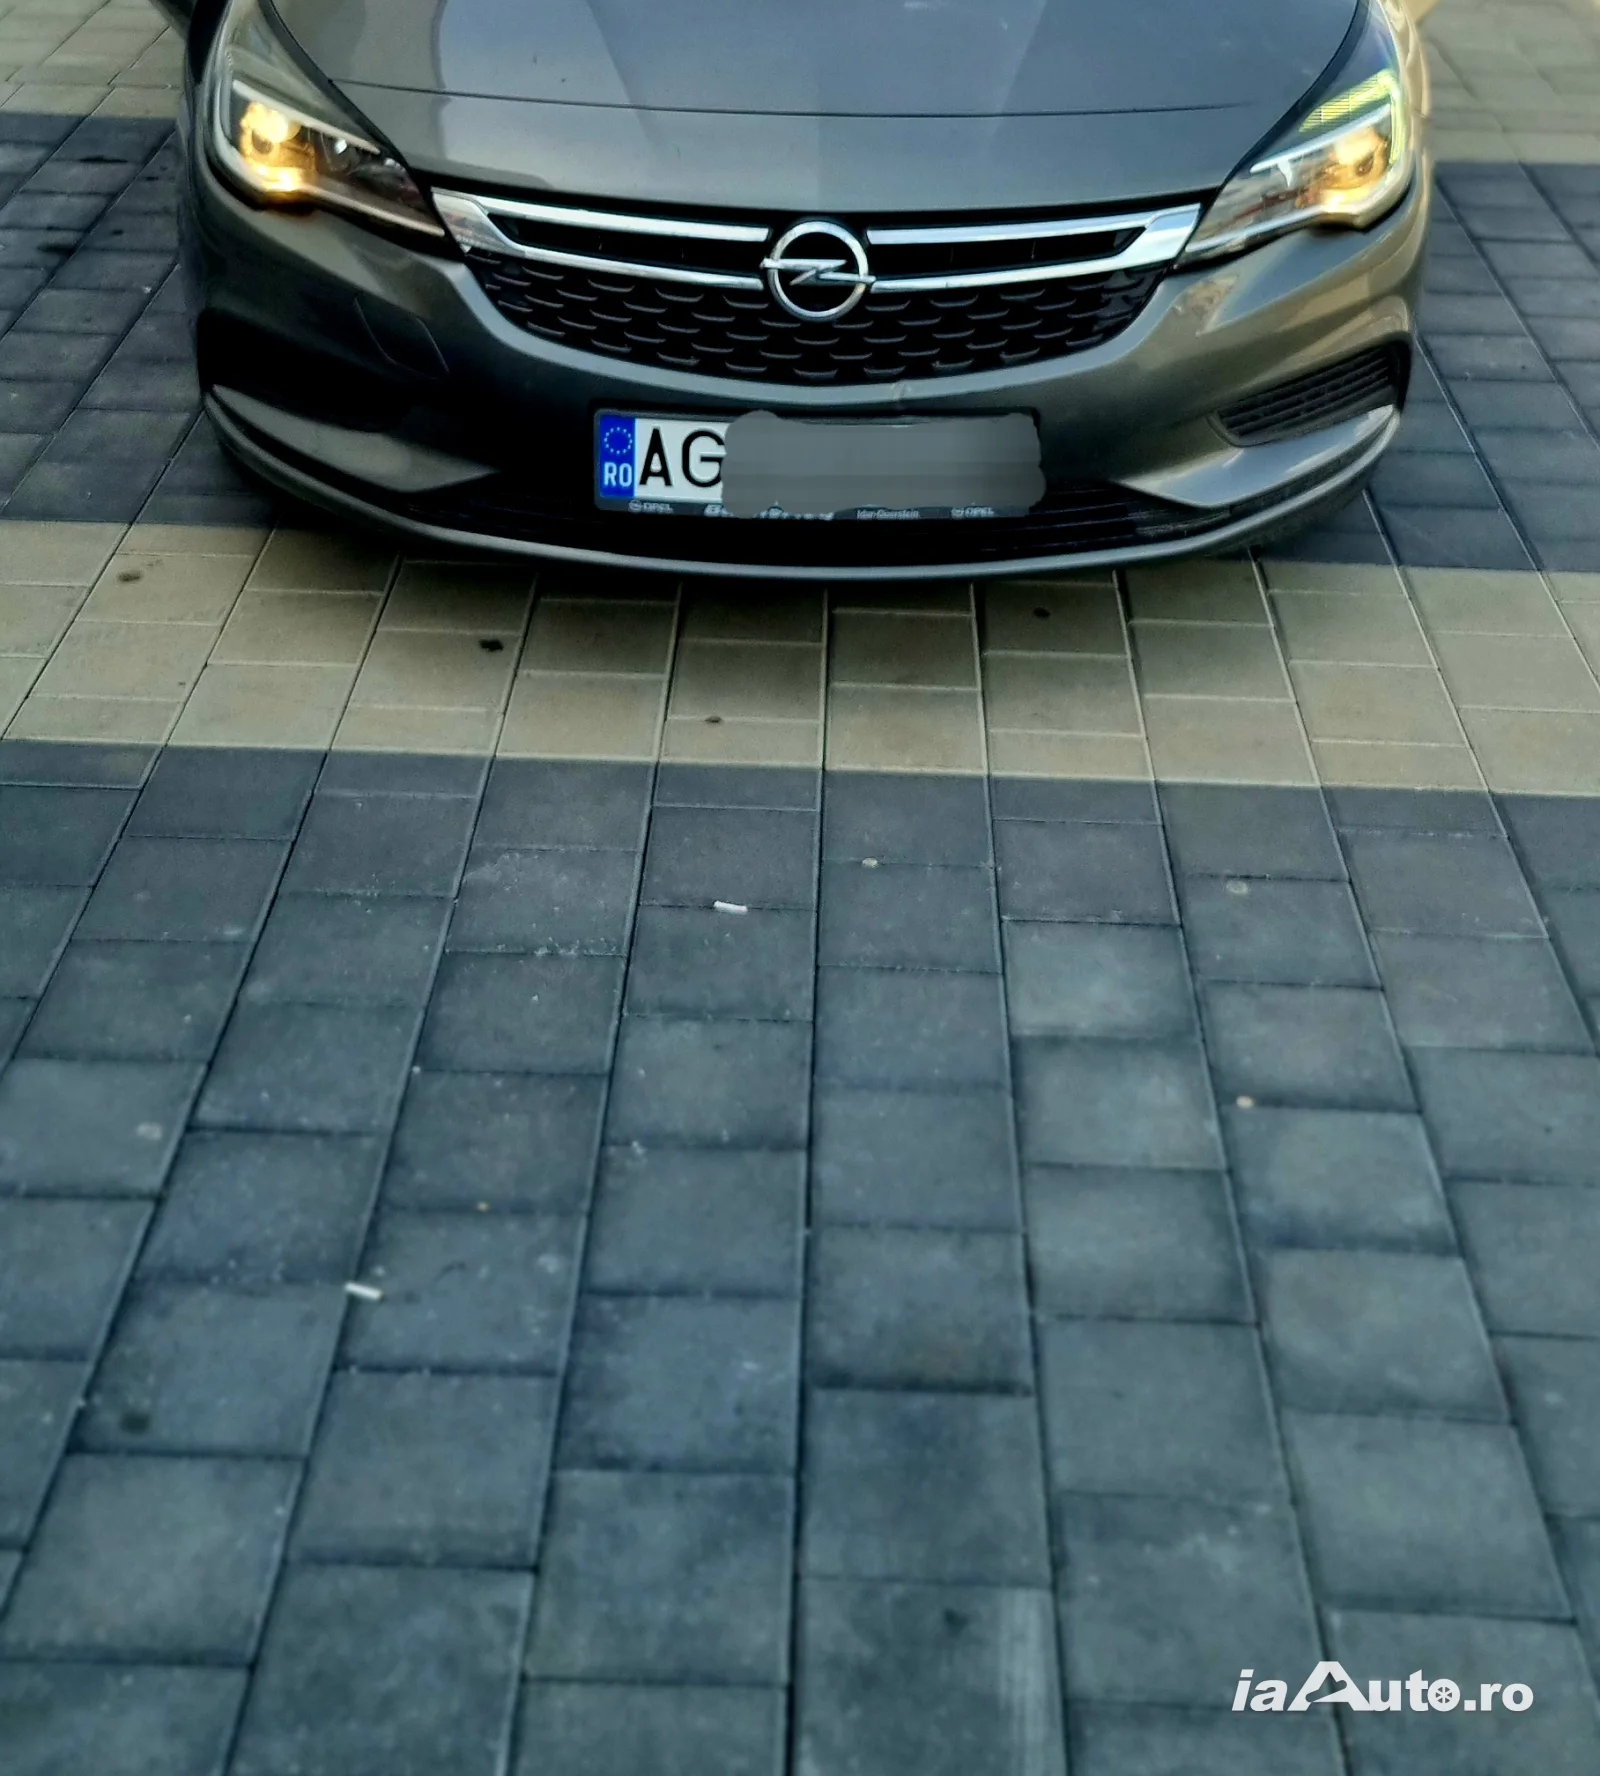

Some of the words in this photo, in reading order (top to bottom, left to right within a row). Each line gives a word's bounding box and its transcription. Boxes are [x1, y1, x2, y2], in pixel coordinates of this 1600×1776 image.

[639, 427, 725, 488] AG
[604, 461, 632, 487] RO
[643, 502, 674, 514] OPEL
[965, 506, 995, 518] OPEL
